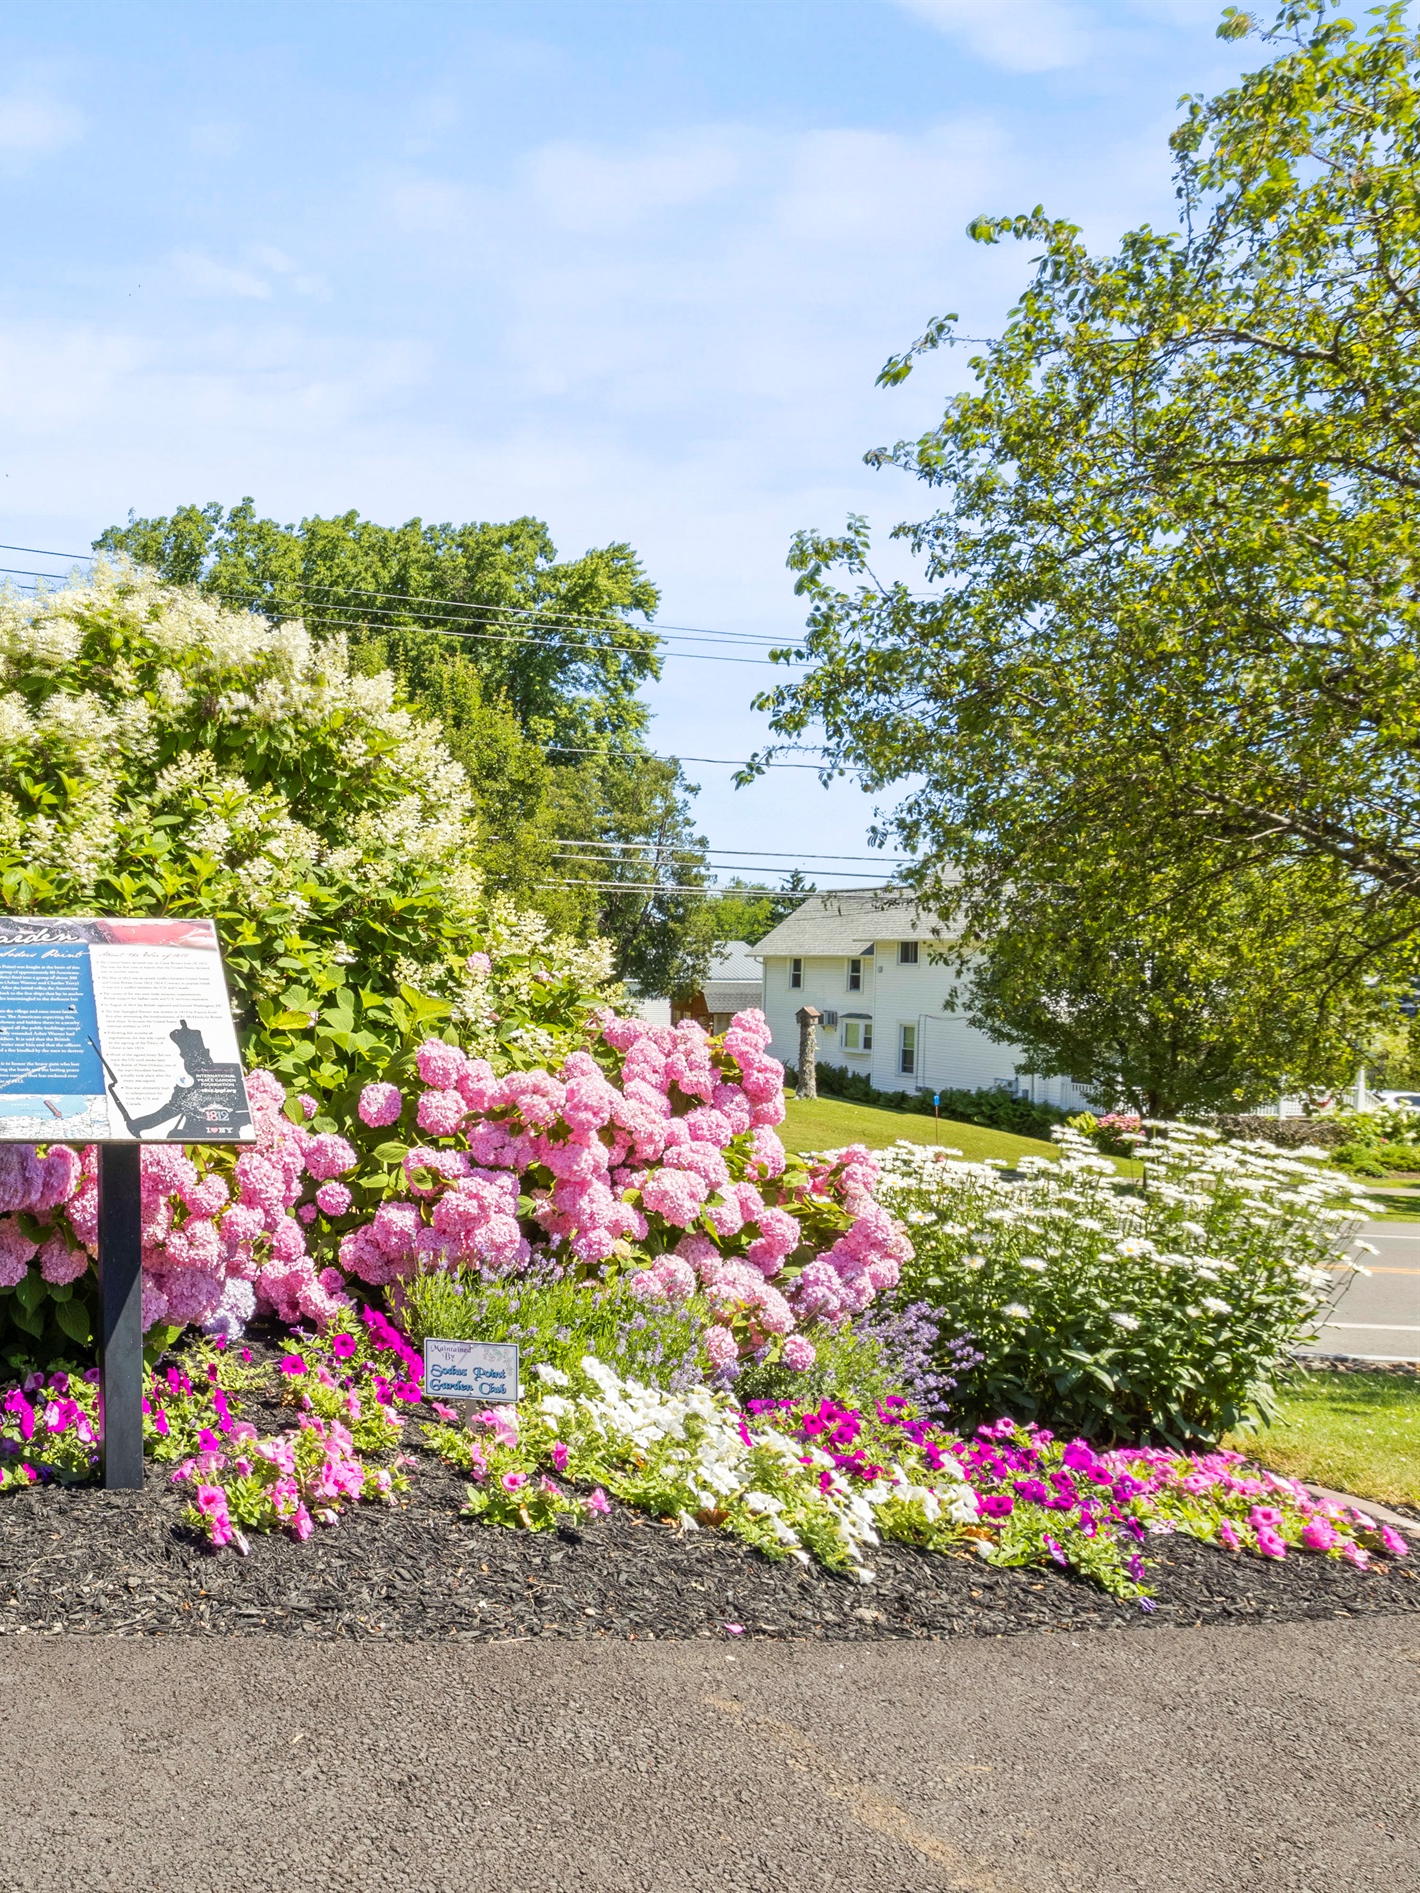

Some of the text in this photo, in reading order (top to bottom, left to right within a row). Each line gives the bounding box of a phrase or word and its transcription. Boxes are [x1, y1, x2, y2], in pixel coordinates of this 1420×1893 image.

[42, 948, 86, 958] Point
[205, 1110, 230, 1121] 1812
[430, 1344, 472, 1354] Maintained
[442, 1352, 456, 1362] By
[430, 1364, 506, 1382] Sodus Point
[430, 1379, 507, 1395] Garden Club
